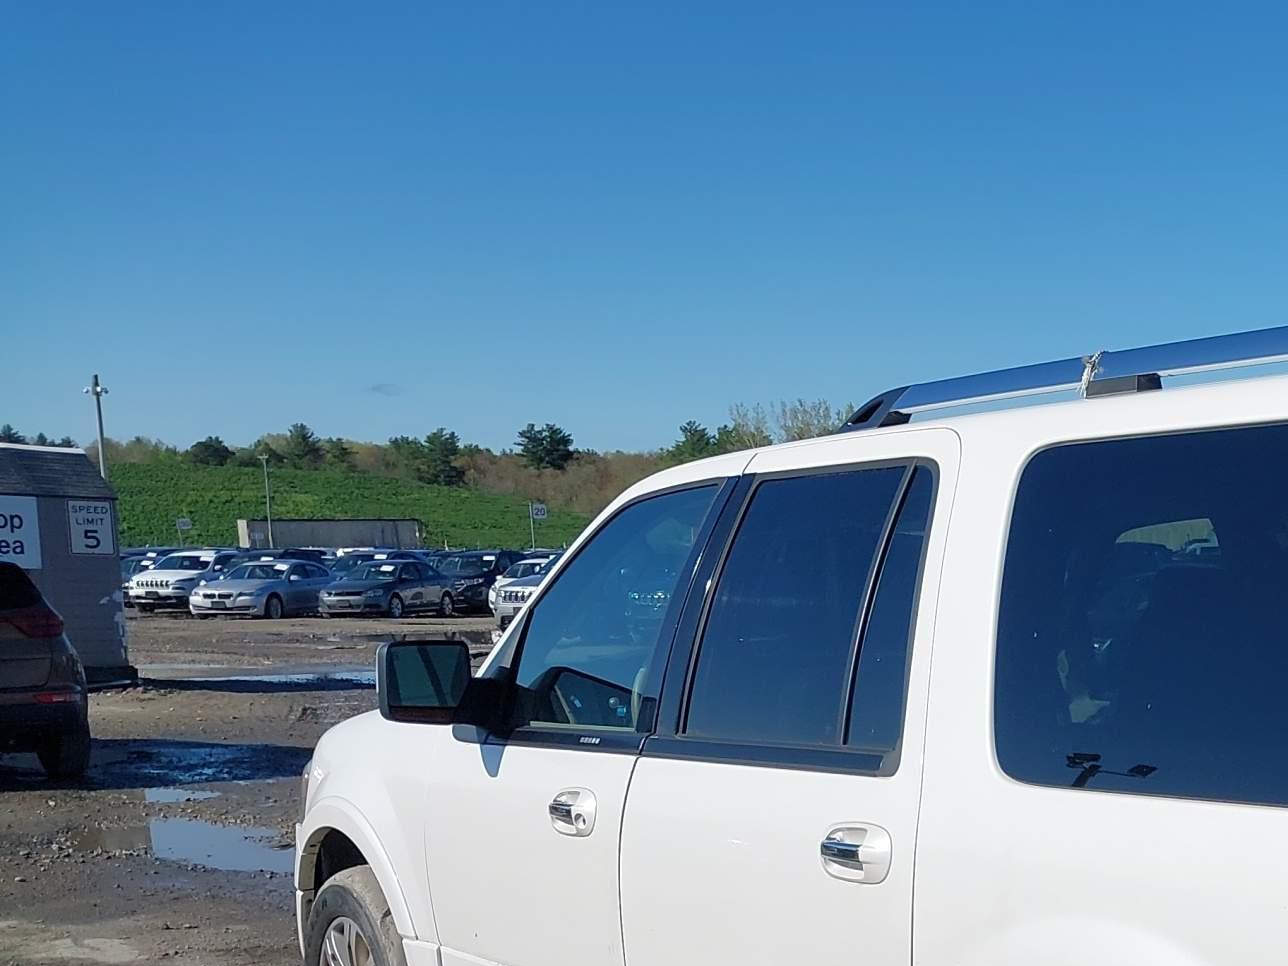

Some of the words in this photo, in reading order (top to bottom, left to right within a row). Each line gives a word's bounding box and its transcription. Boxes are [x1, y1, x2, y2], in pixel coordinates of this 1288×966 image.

[71, 505, 108, 514] SPEED
[75, 518, 105, 526] LIMIT
[84, 529, 101, 549] 5
